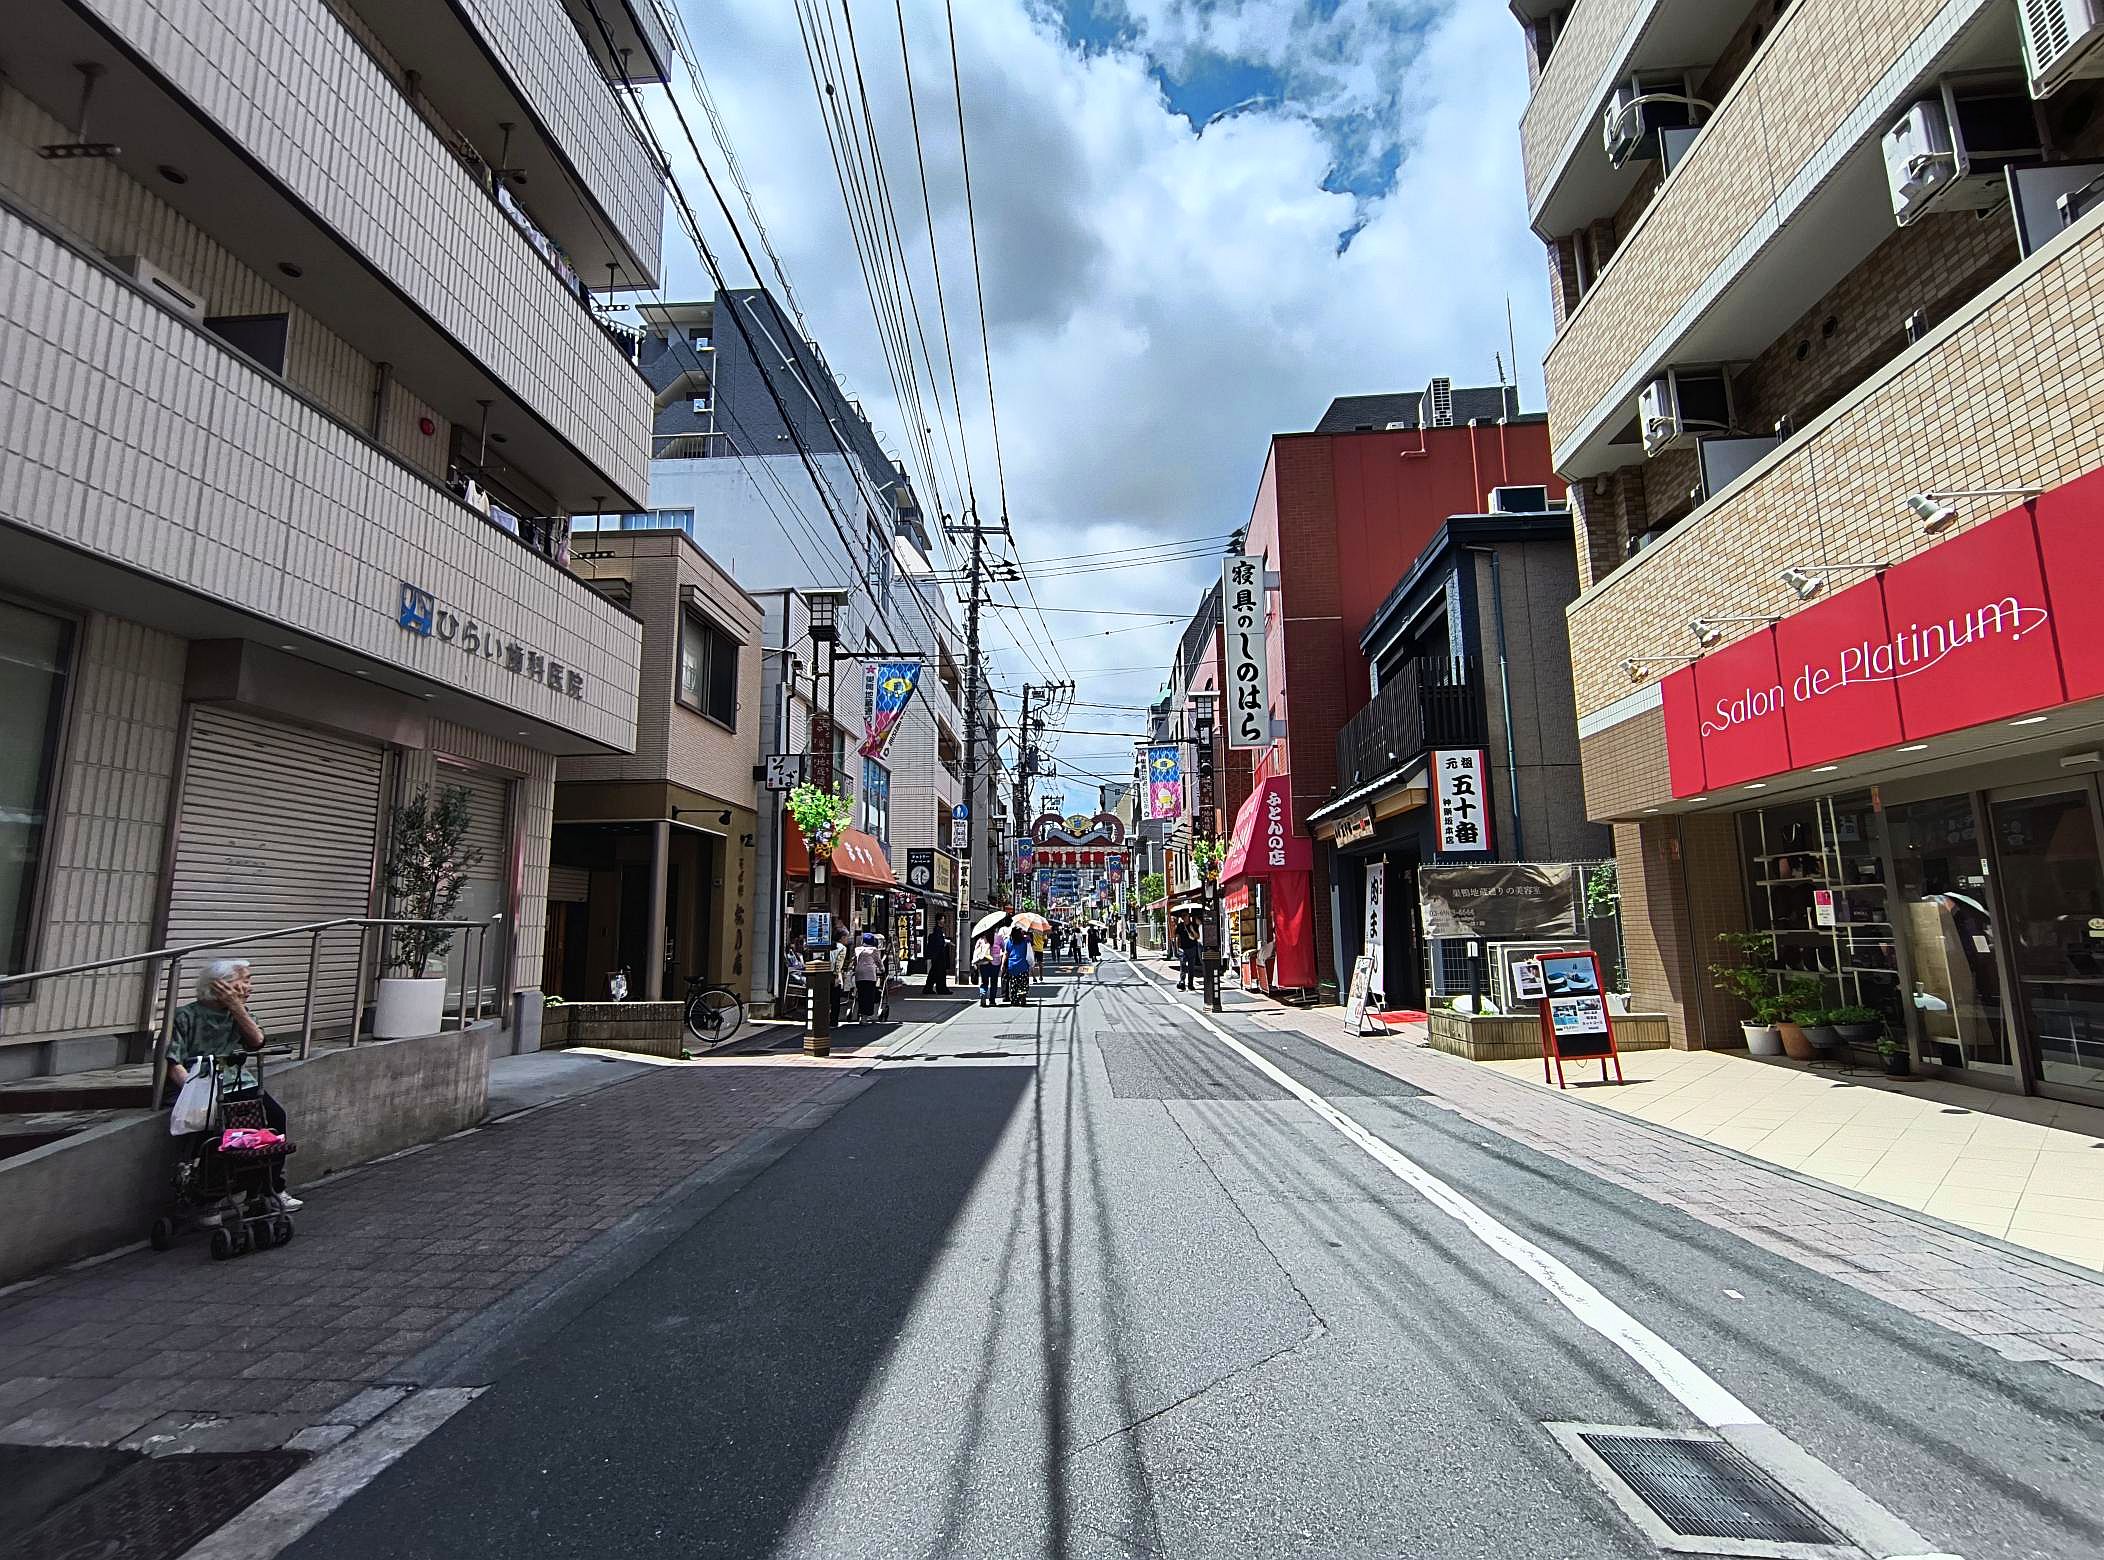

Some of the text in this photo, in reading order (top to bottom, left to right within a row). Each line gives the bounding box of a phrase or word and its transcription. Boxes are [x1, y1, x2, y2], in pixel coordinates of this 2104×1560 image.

[435, 608, 585, 701] ひらい歯科医院
[1231, 560, 1262, 741] 寝具のしのはら
[1701, 684, 1785, 737] Salon
[1793, 664, 1831, 702] de
[772, 757, 798, 787] そば
[1445, 757, 1474, 769] 元祖
[1266, 791, 1286, 866] ふとんの店
[1451, 774, 1479, 844] 五十番
